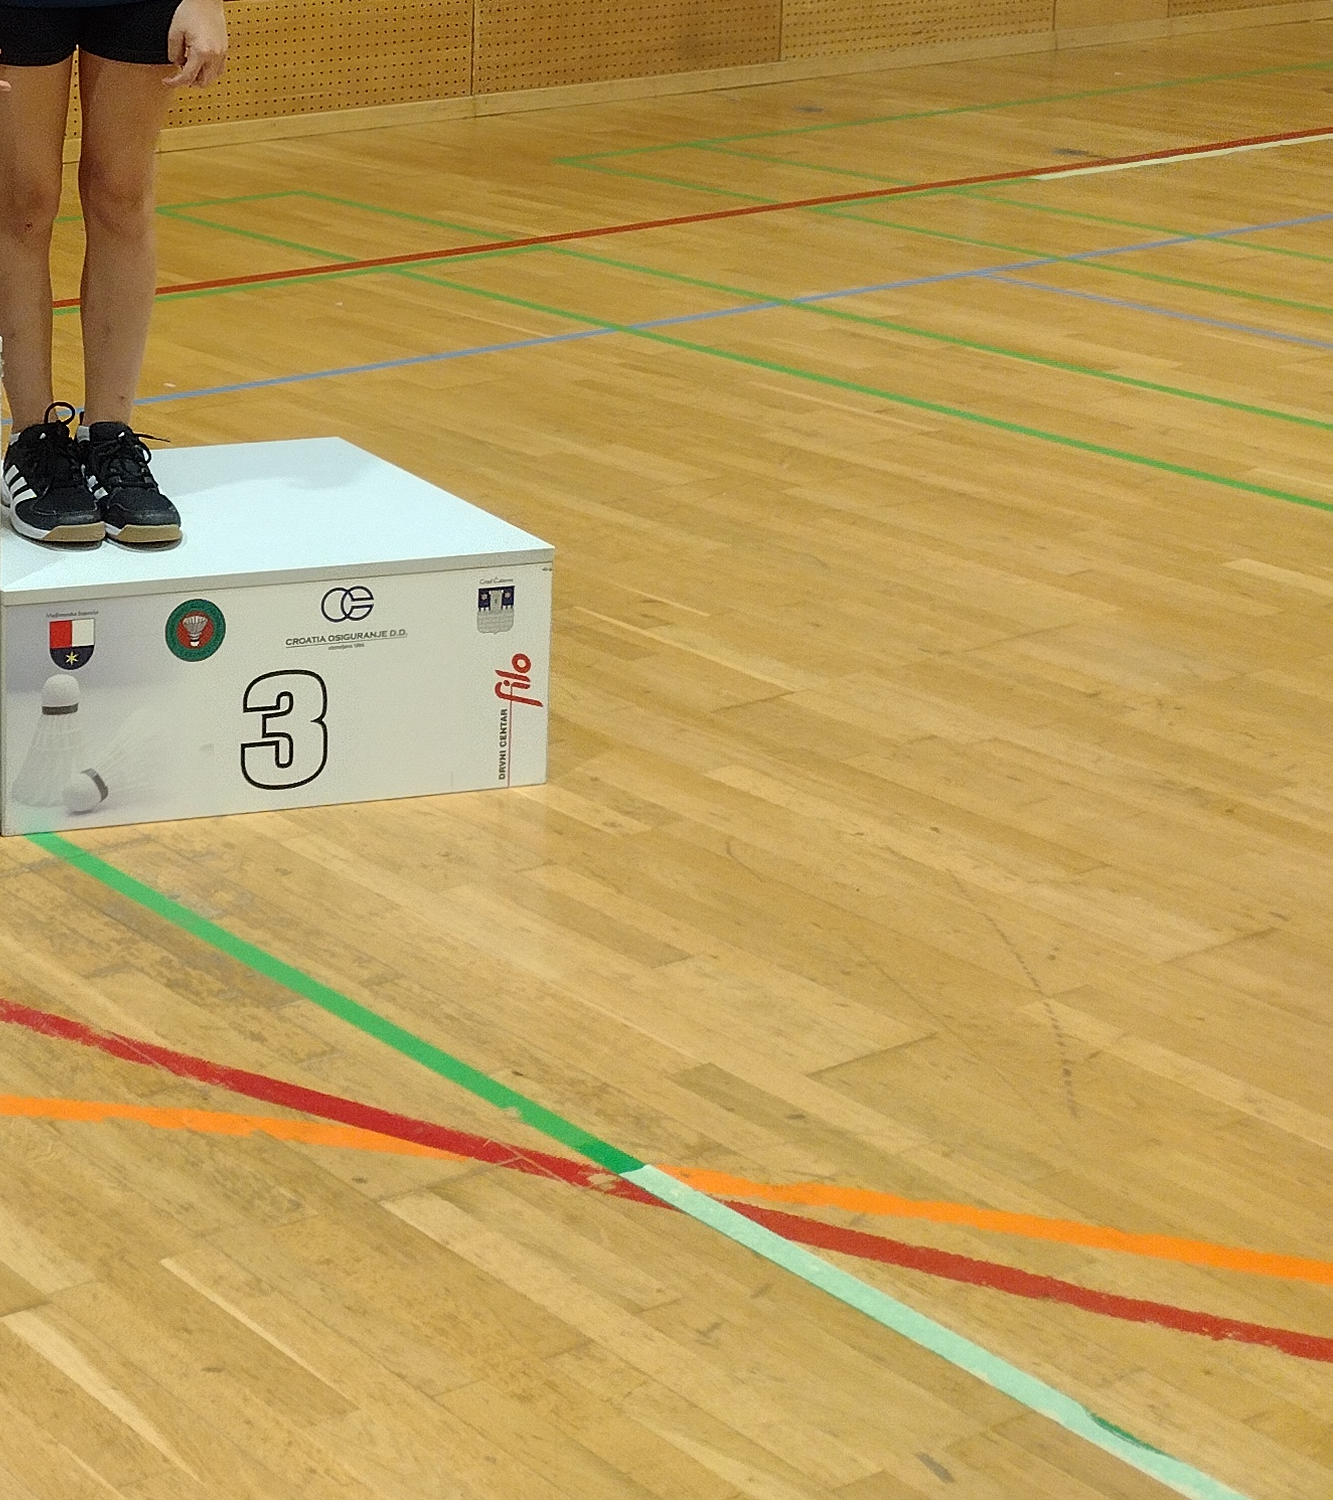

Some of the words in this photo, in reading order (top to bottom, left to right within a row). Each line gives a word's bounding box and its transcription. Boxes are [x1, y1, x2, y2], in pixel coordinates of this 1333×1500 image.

[285, 635, 327, 646] CROATIA
[327, 630, 388, 642] OSIGURANJE
[494, 652, 544, 707] filo
[240, 669, 328, 790] 3
[499, 708, 508, 747] CENTAR
[498, 750, 507, 780] DRVNI
